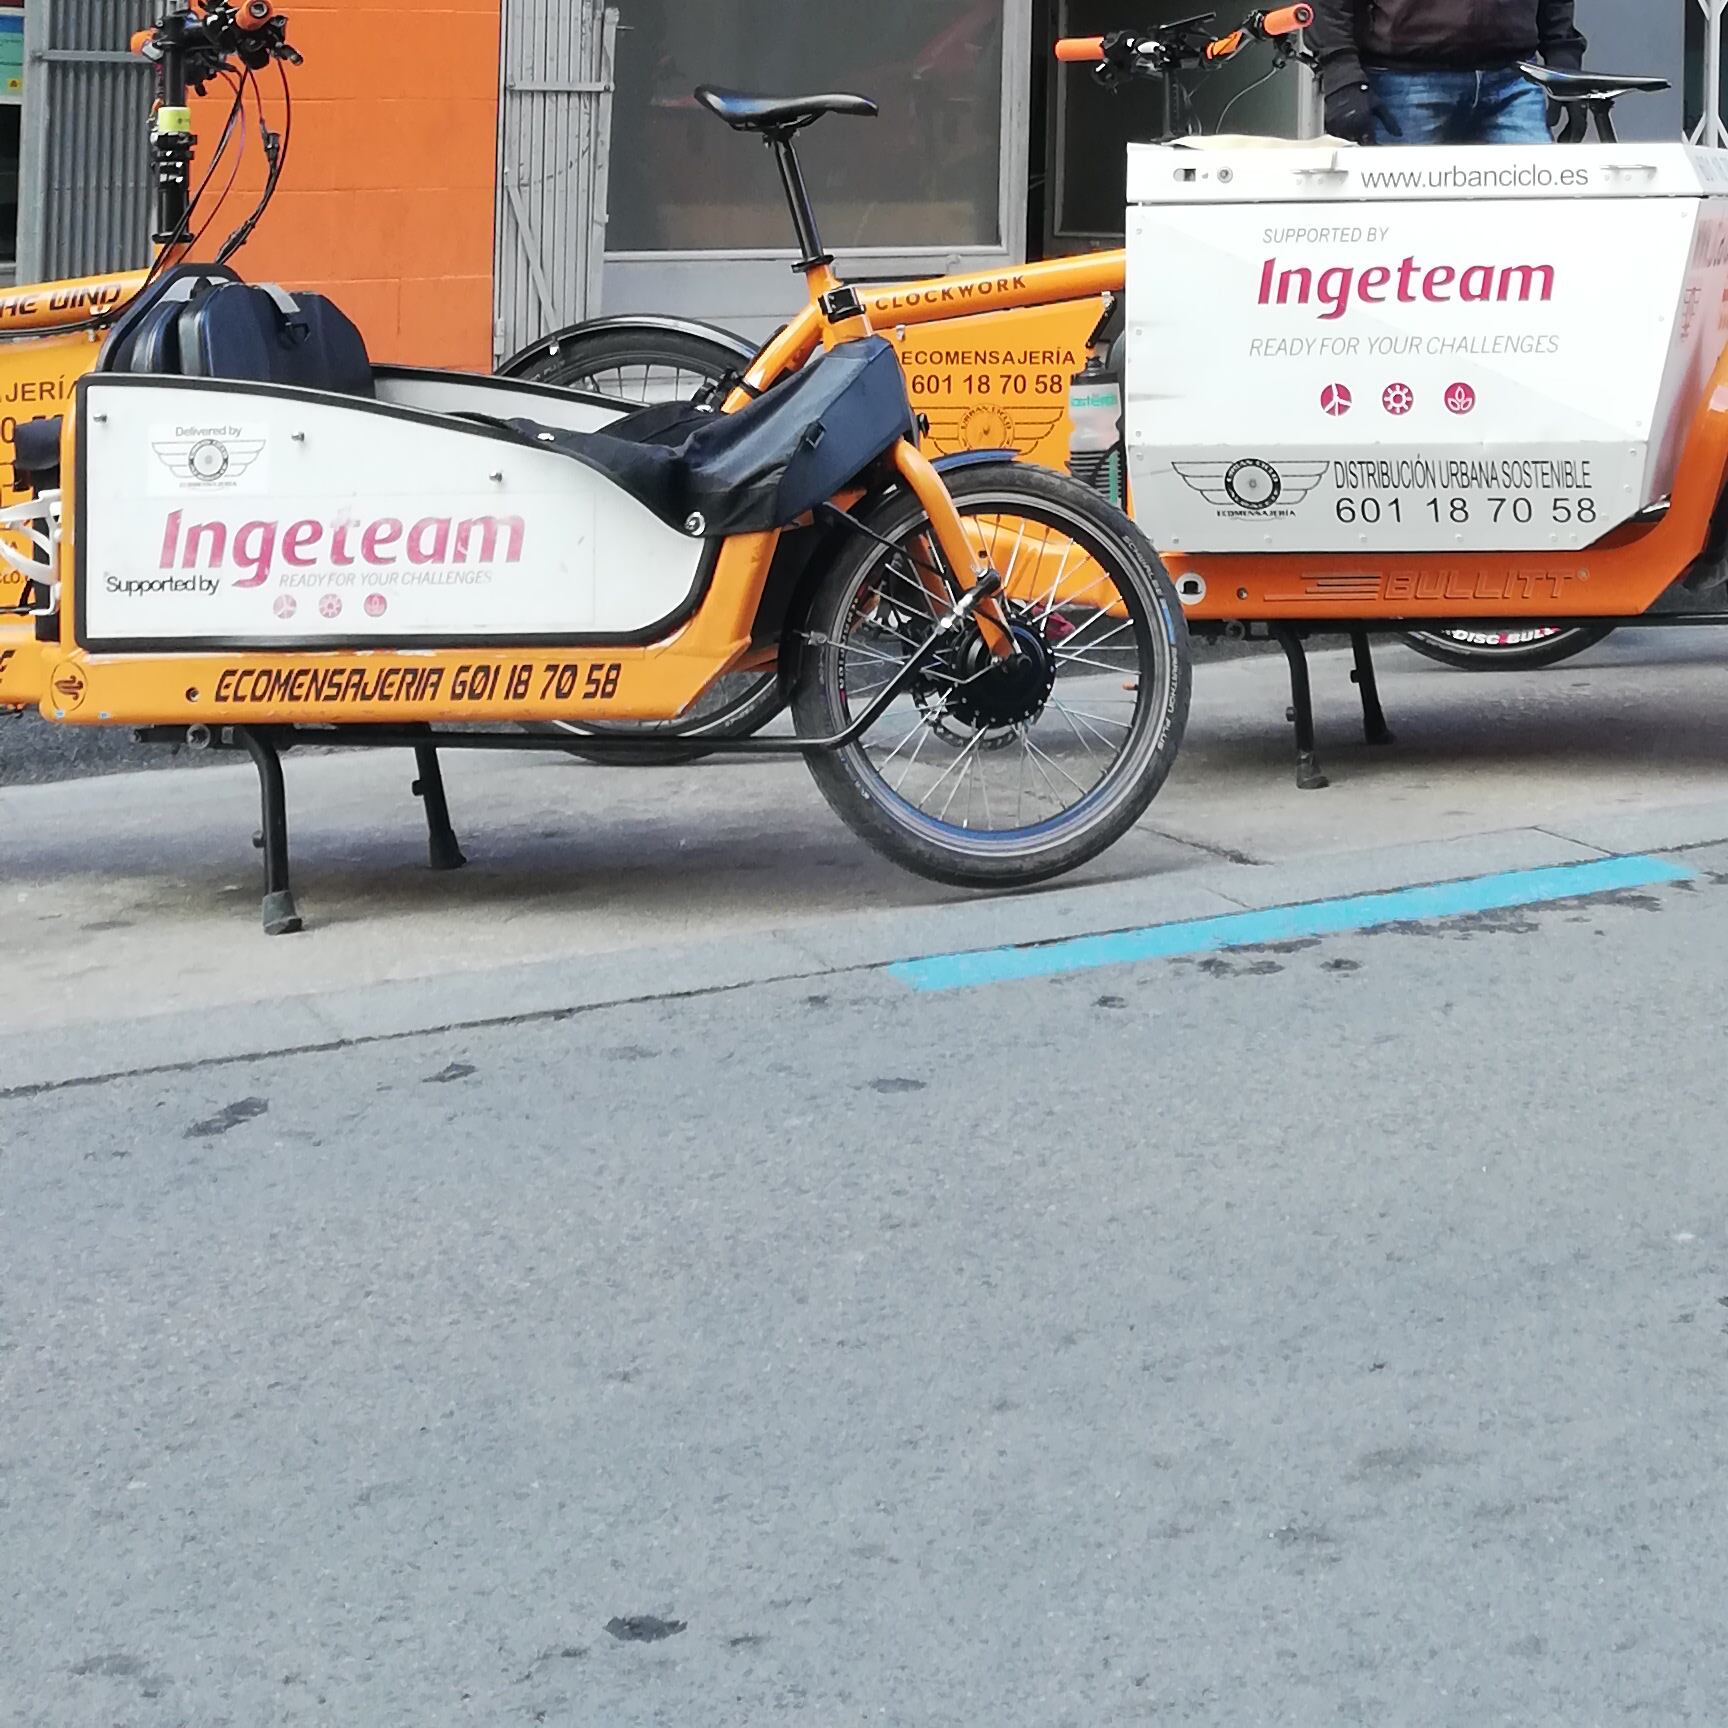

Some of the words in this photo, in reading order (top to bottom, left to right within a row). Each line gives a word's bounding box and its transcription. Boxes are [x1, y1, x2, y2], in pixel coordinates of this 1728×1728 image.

[1361, 164, 1589, 189] www.urbanciclo.es
[1262, 227, 1362, 244] SUPPORTED
[1366, 226, 1389, 242] BY
[875, 275, 1027, 311] CLOCKWORK
[1258, 255, 1555, 320] Ingeteam
[901, 346, 1076, 366] ECOMENSAJERÍA
[1249, 337, 1316, 357] READY
[1319, 337, 1360, 356] FOR
[1368, 336, 1422, 356] YOUR
[1426, 334, 1560, 355] CHALLENGES
[912, 374, 952, 395] 601
[963, 374, 991, 394] 18
[1000, 374, 1027, 394] 70
[1035, 373, 1063, 394] 58
[175, 426, 227, 437] Delivered
[228, 425, 242, 437] by
[1334, 453, 1436, 489] DISTRIBUCIÓN
[1440, 460, 1500, 489] URBANA
[1502, 459, 1592, 489] SOSTENIBLE
[1336, 497, 1402, 523] 601
[1426, 497, 1469, 523] 18
[1487, 497, 1533, 523] 70
[1552, 497, 1597, 523] 58
[159, 506, 525, 589] Ingeteam
[106, 575, 195, 597] Supported
[199, 574, 220, 595] by
[279, 572, 324, 588] READY
[327, 572, 356, 587] FOR
[360, 571, 399, 586] YOUR
[401, 570, 493, 586] CHALLENGES
[1383, 571, 1574, 600] BULLITT
[1451, 629, 1499, 645] DISC
[214, 666, 446, 703] ECOMENSAJERIA
[504, 664, 534, 701] 18
[540, 663, 578, 700] 70
[582, 662, 622, 700] 58
